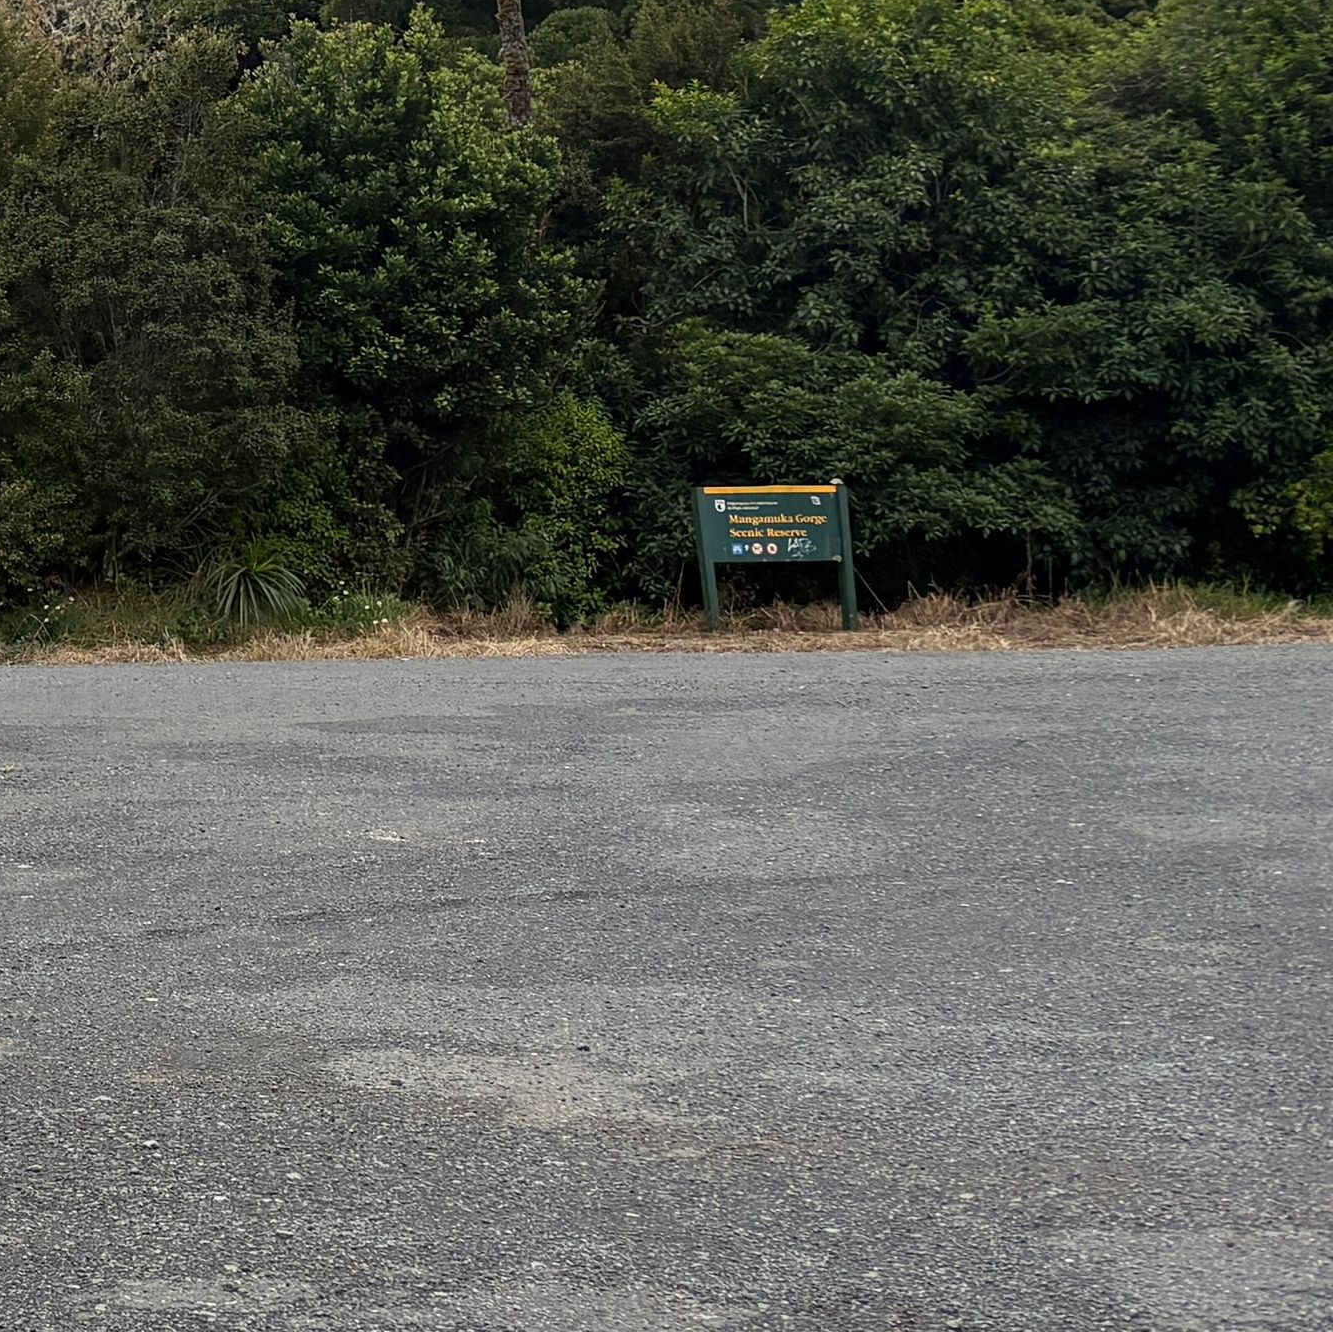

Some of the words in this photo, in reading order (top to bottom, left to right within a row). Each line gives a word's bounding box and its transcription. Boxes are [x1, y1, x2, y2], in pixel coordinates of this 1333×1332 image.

[729, 514, 794, 526] Mangamuka
[795, 514, 827, 525] Gorge
[729, 528, 764, 537] Scenic
[767, 528, 807, 537] Reserve
